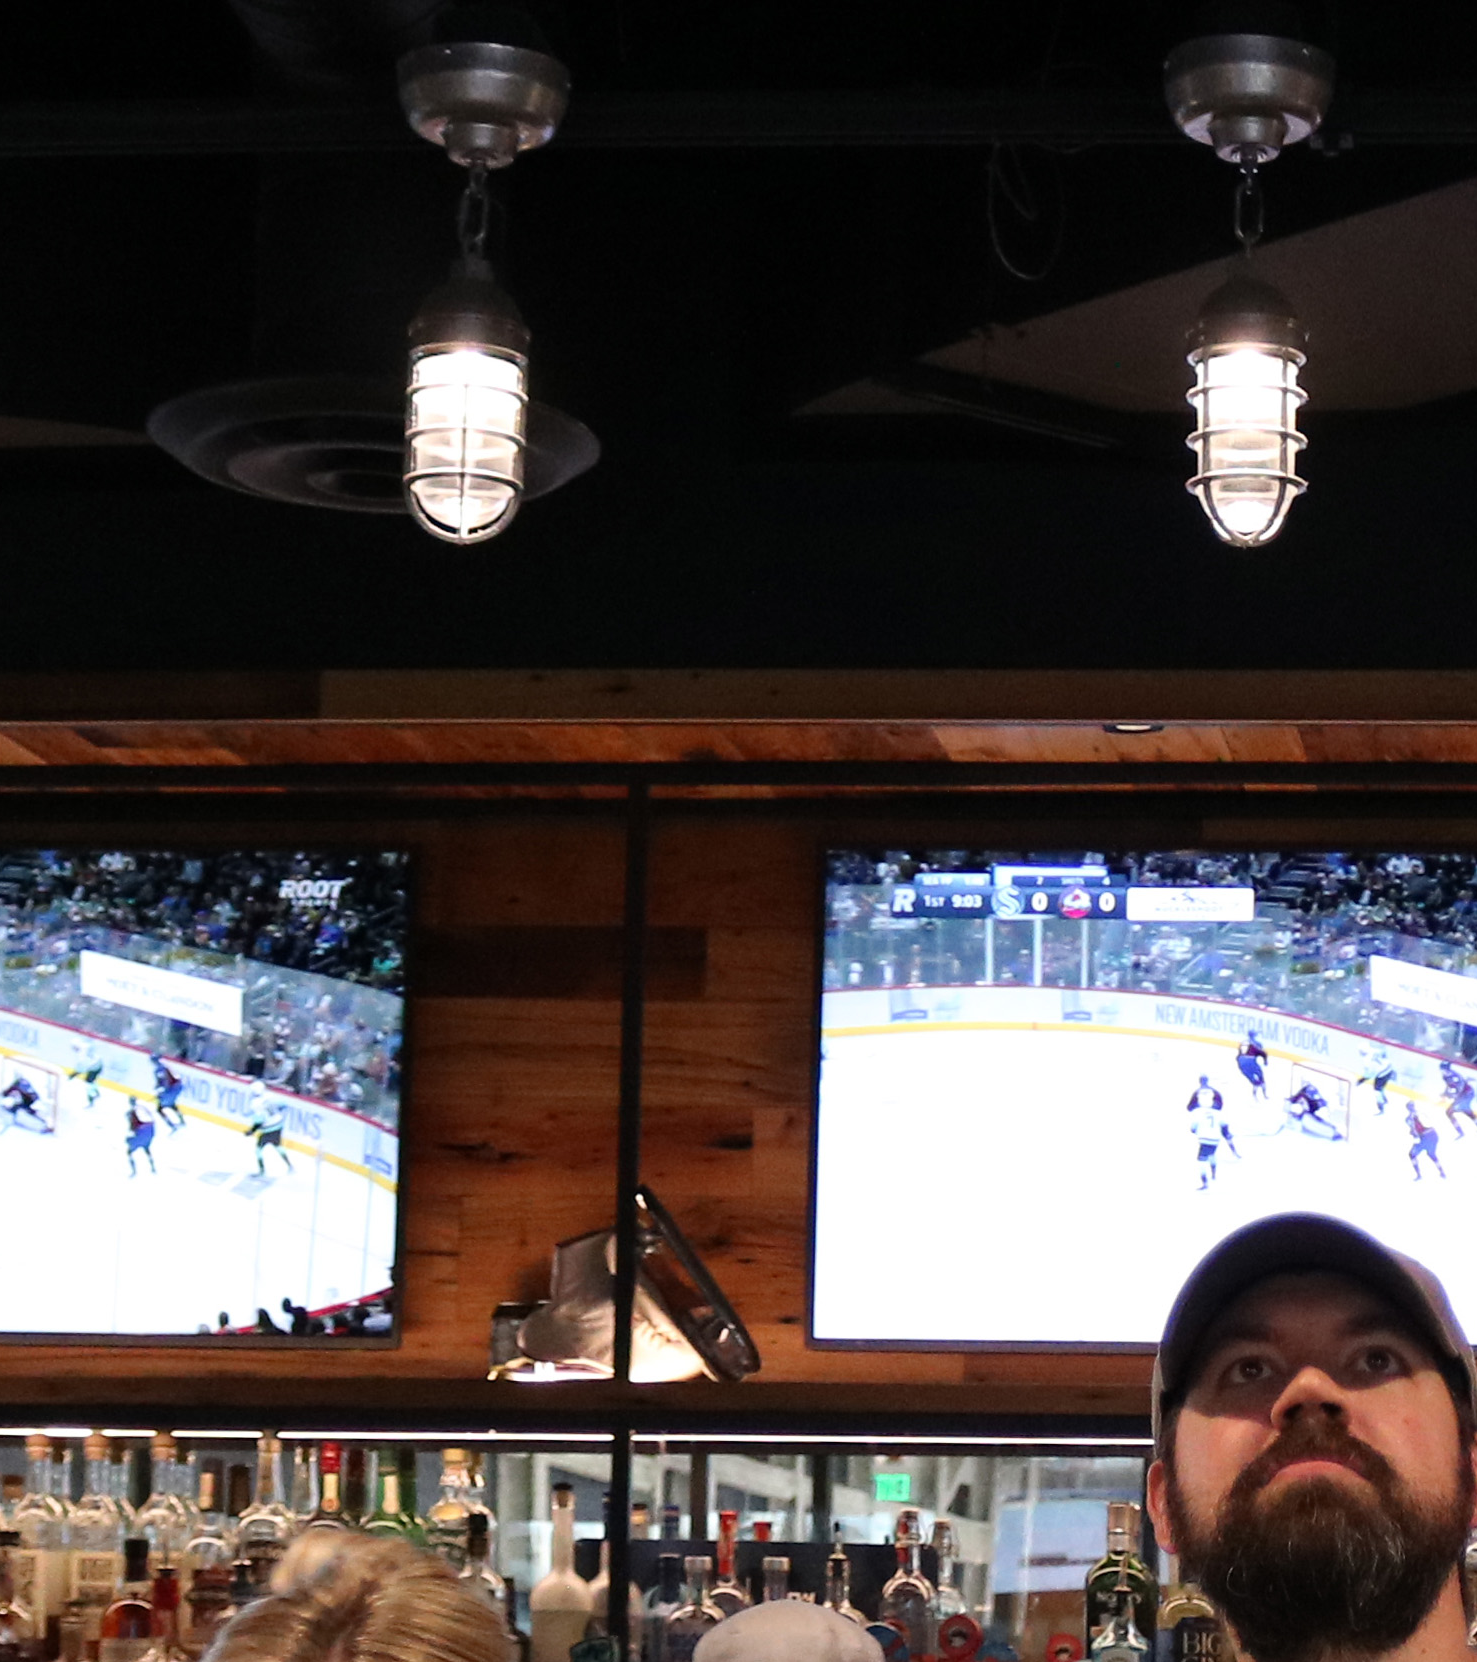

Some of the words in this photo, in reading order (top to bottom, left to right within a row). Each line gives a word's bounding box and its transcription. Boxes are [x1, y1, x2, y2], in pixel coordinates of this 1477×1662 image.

[279, 879, 346, 899] ROOT
[951, 894, 983, 908] 9:03
[1155, 1002, 1188, 1025] NEW
[1188, 1006, 1283, 1044] AMSTERDAM
[1282, 1022, 1331, 1055] VODKA
[215, 1080, 254, 1118] YOU
[1182, 1630, 1222, 1655] BIG
